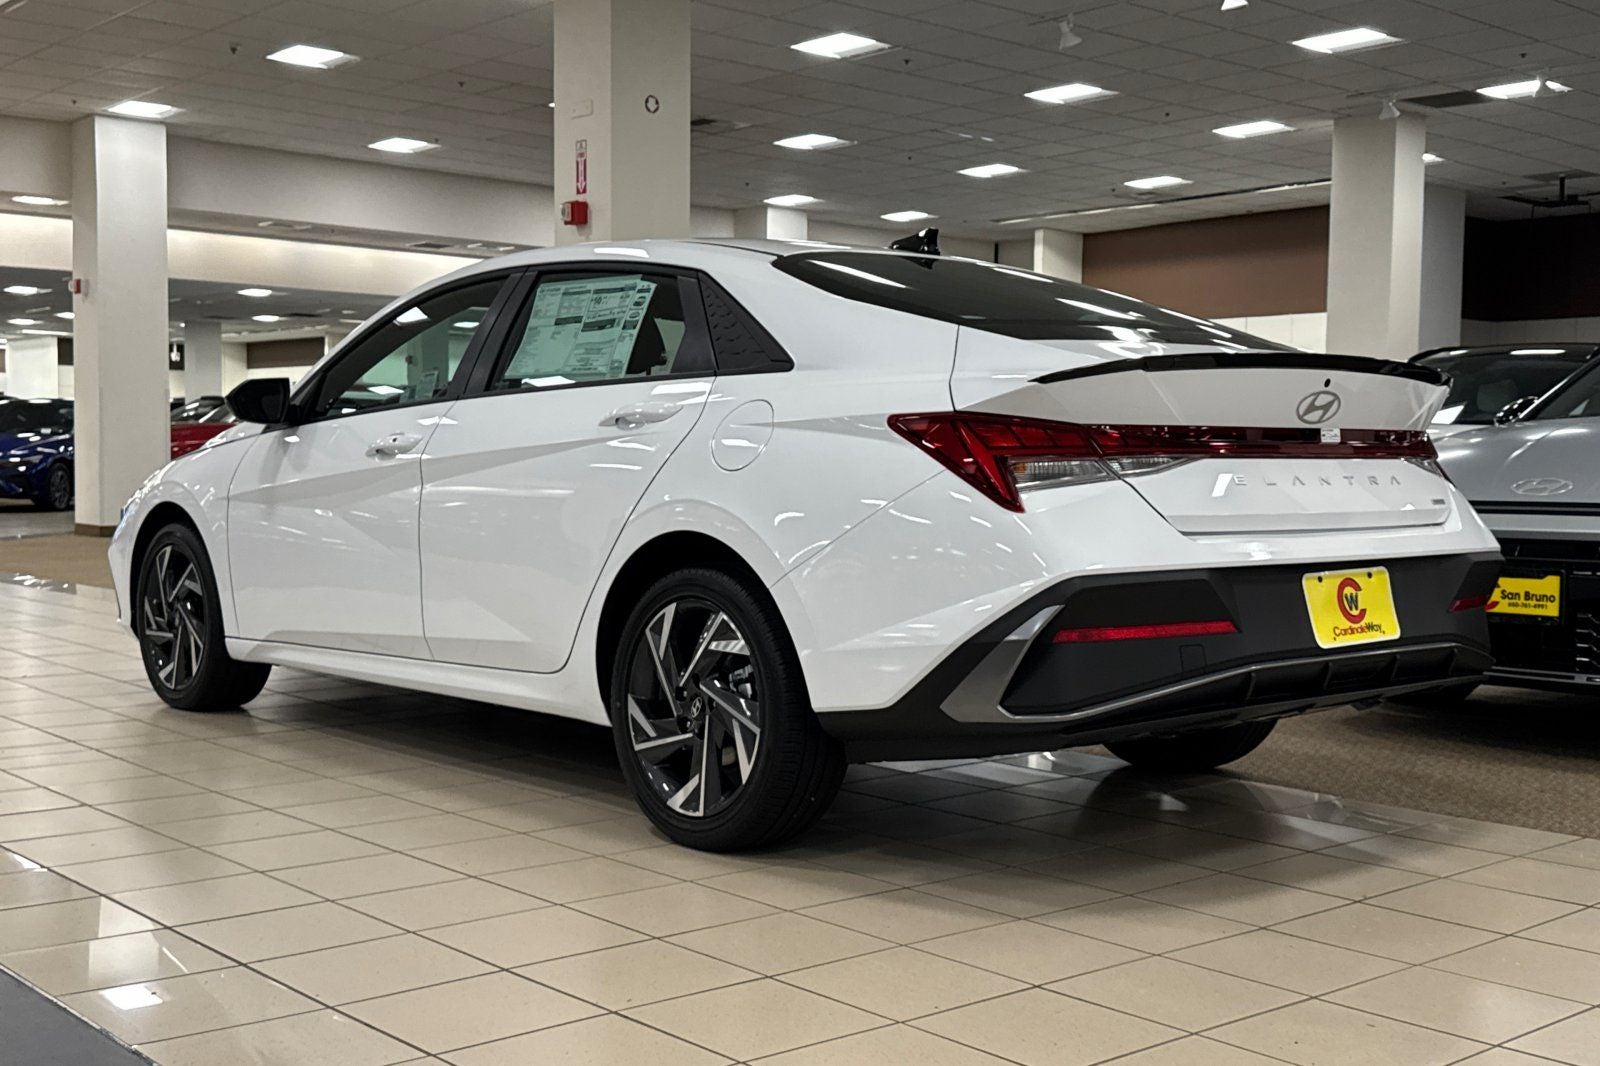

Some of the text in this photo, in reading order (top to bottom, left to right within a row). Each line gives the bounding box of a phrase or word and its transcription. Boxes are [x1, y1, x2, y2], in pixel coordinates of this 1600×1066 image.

[1233, 475, 1402, 486] ELANTRA
[1500, 589, 1556, 603] San Bruno
